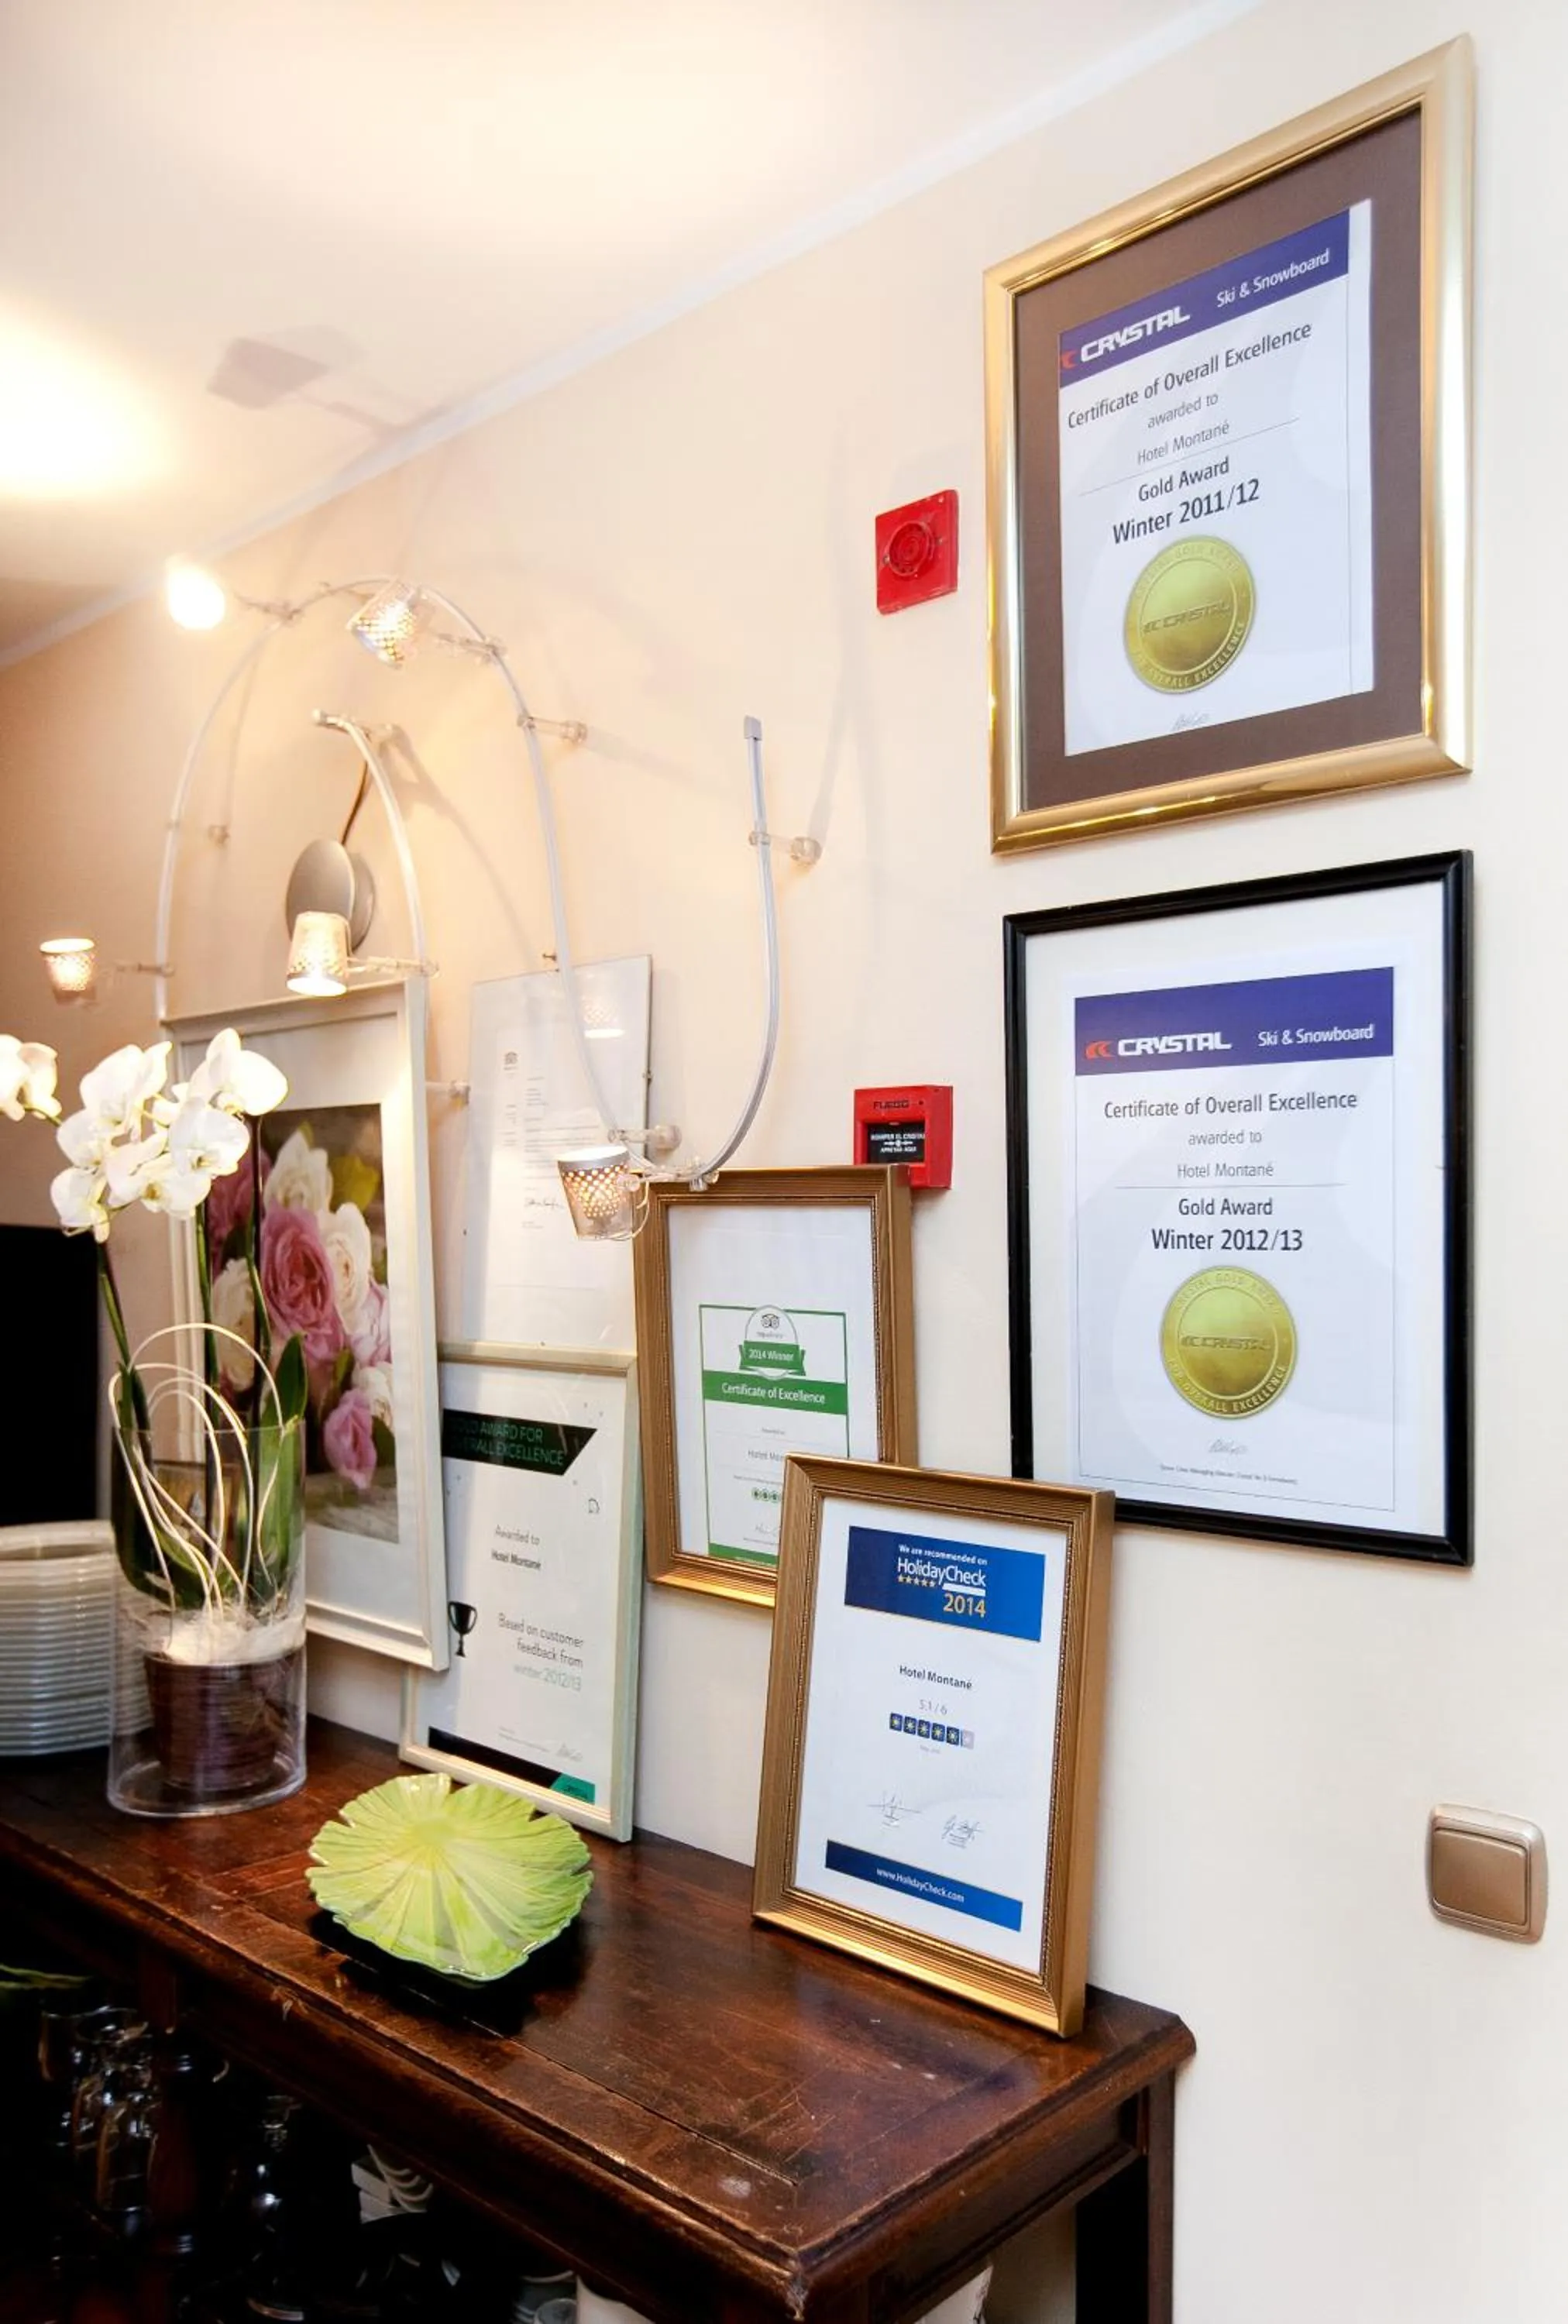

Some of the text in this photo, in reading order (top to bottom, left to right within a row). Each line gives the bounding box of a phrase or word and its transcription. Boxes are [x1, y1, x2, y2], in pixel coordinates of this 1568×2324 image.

[1216, 249, 1330, 308] Ski & Snowboard
[1081, 306, 1191, 363] CRYSTAL
[1068, 323, 1312, 428] Certificate of Overall Excellence
[1147, 392, 1219, 428] awarded to
[1137, 421, 1230, 465] Hotel Montané
[1138, 457, 1230, 502] Gold Award
[1112, 478, 1260, 545] Winter 2011/12
[1118, 1031, 1233, 1057] CRYSTAL
[1258, 1024, 1375, 1047] Ski & Snowboard
[1104, 1092, 1358, 1119] Certificate of Overall Excellence
[1188, 1129, 1263, 1146] awarded to
[1178, 1160, 1274, 1178] Hotel Montané
[1178, 1198, 1274, 1216] Gold Award
[1151, 1228, 1303, 1251] Winter 2012/13
[748, 1348, 794, 1361] 2014 Winner
[721, 1382, 826, 1404] Certificate of Excellence
[480, 1422, 518, 1439] AWARD
[520, 1427, 544, 1443] FOR
[496, 1441, 566, 1466] EXCELLENCE
[898, 1544, 988, 1566] We are recommended on
[897, 1557, 986, 1587] HolidayCheck
[943, 1592, 987, 1618] 2014
[527, 1625, 539, 1637] on
[517, 1637, 583, 1668] feedback from
[899, 1665, 926, 1679] Hotel
[875, 1867, 965, 1903] www.HolidayCheck.com
